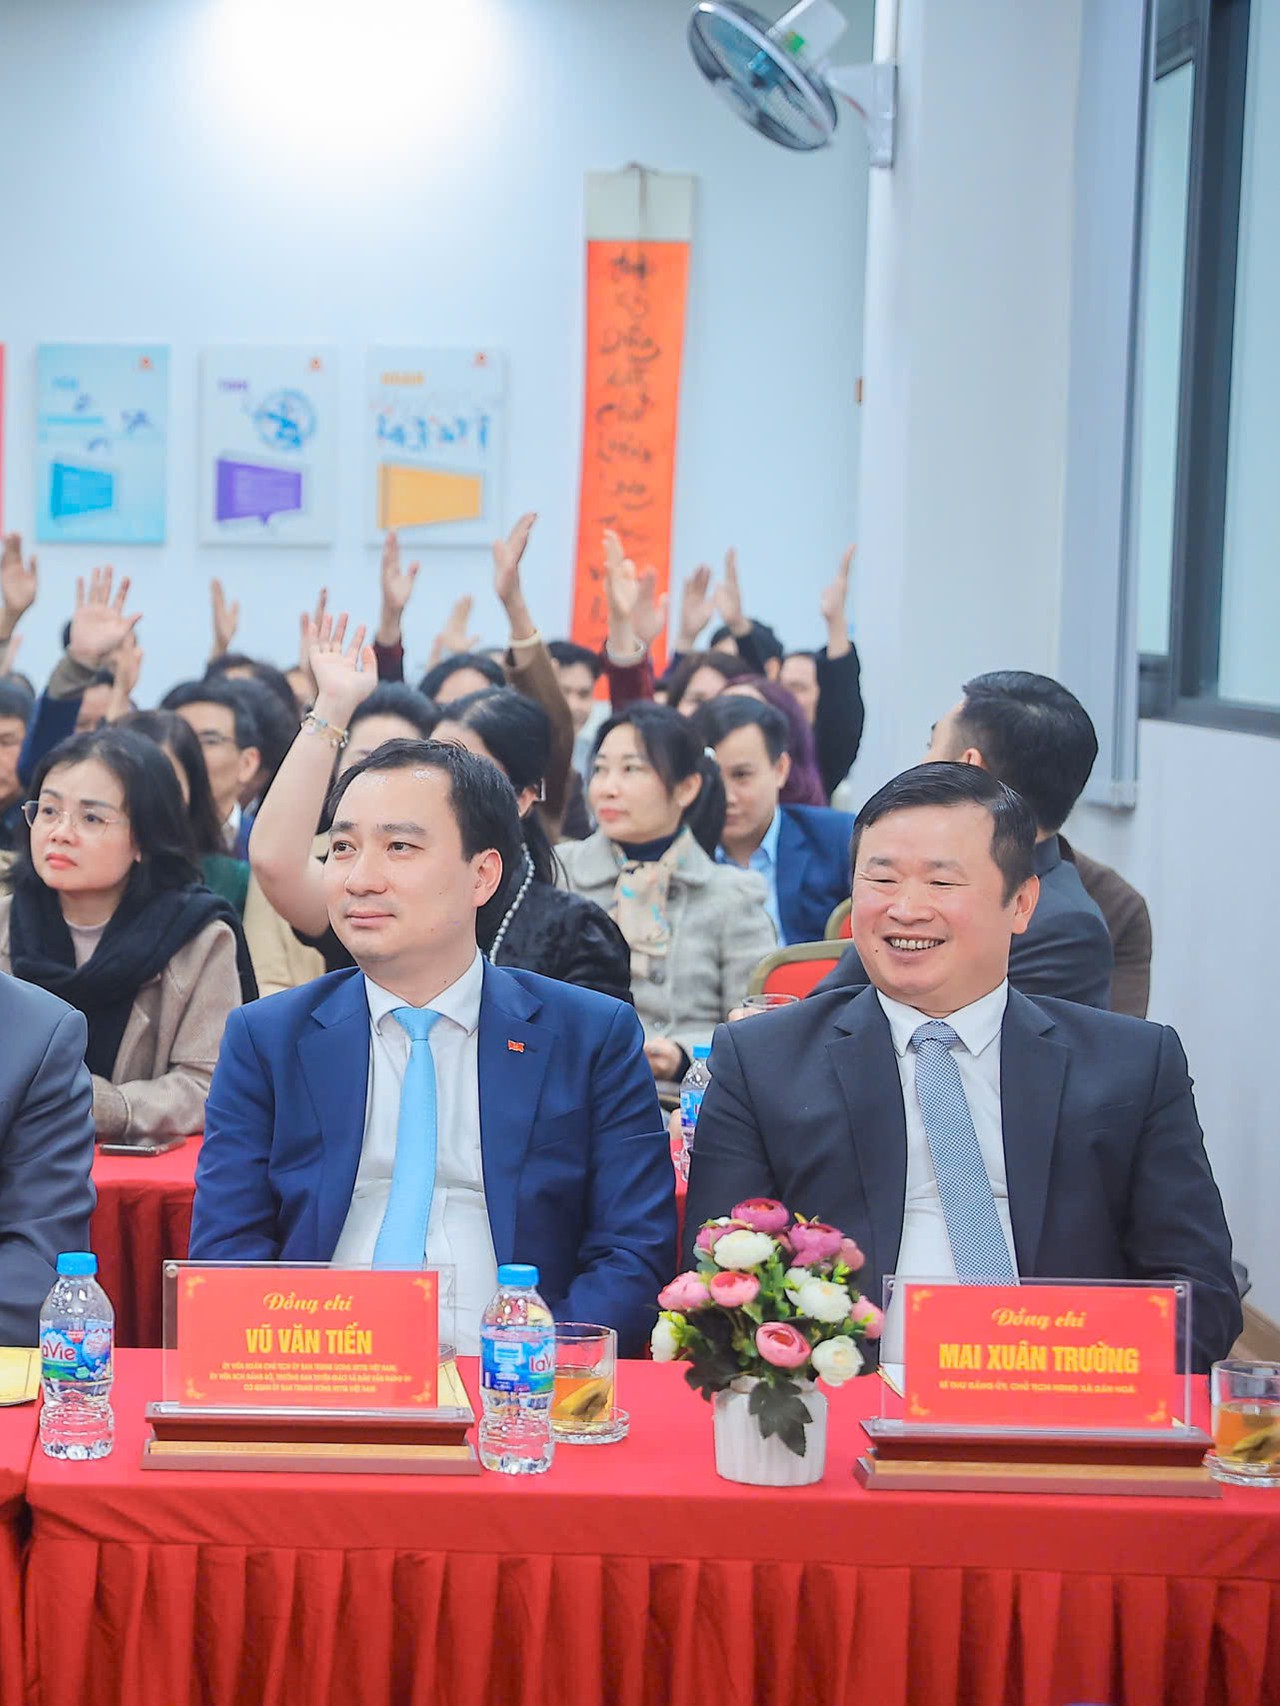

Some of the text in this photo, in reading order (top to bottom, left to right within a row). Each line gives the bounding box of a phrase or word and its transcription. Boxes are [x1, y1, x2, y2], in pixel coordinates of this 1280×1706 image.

[263, 1292, 353, 1314] Đồng chí
[991, 1307, 1049, 1330] Đồng
[42, 1340, 75, 1360] aVie
[246, 1322, 372, 1355] VŨ VĂN TIẾN
[939, 1339, 1140, 1374] MAI XUÂN TRƯỜNG
